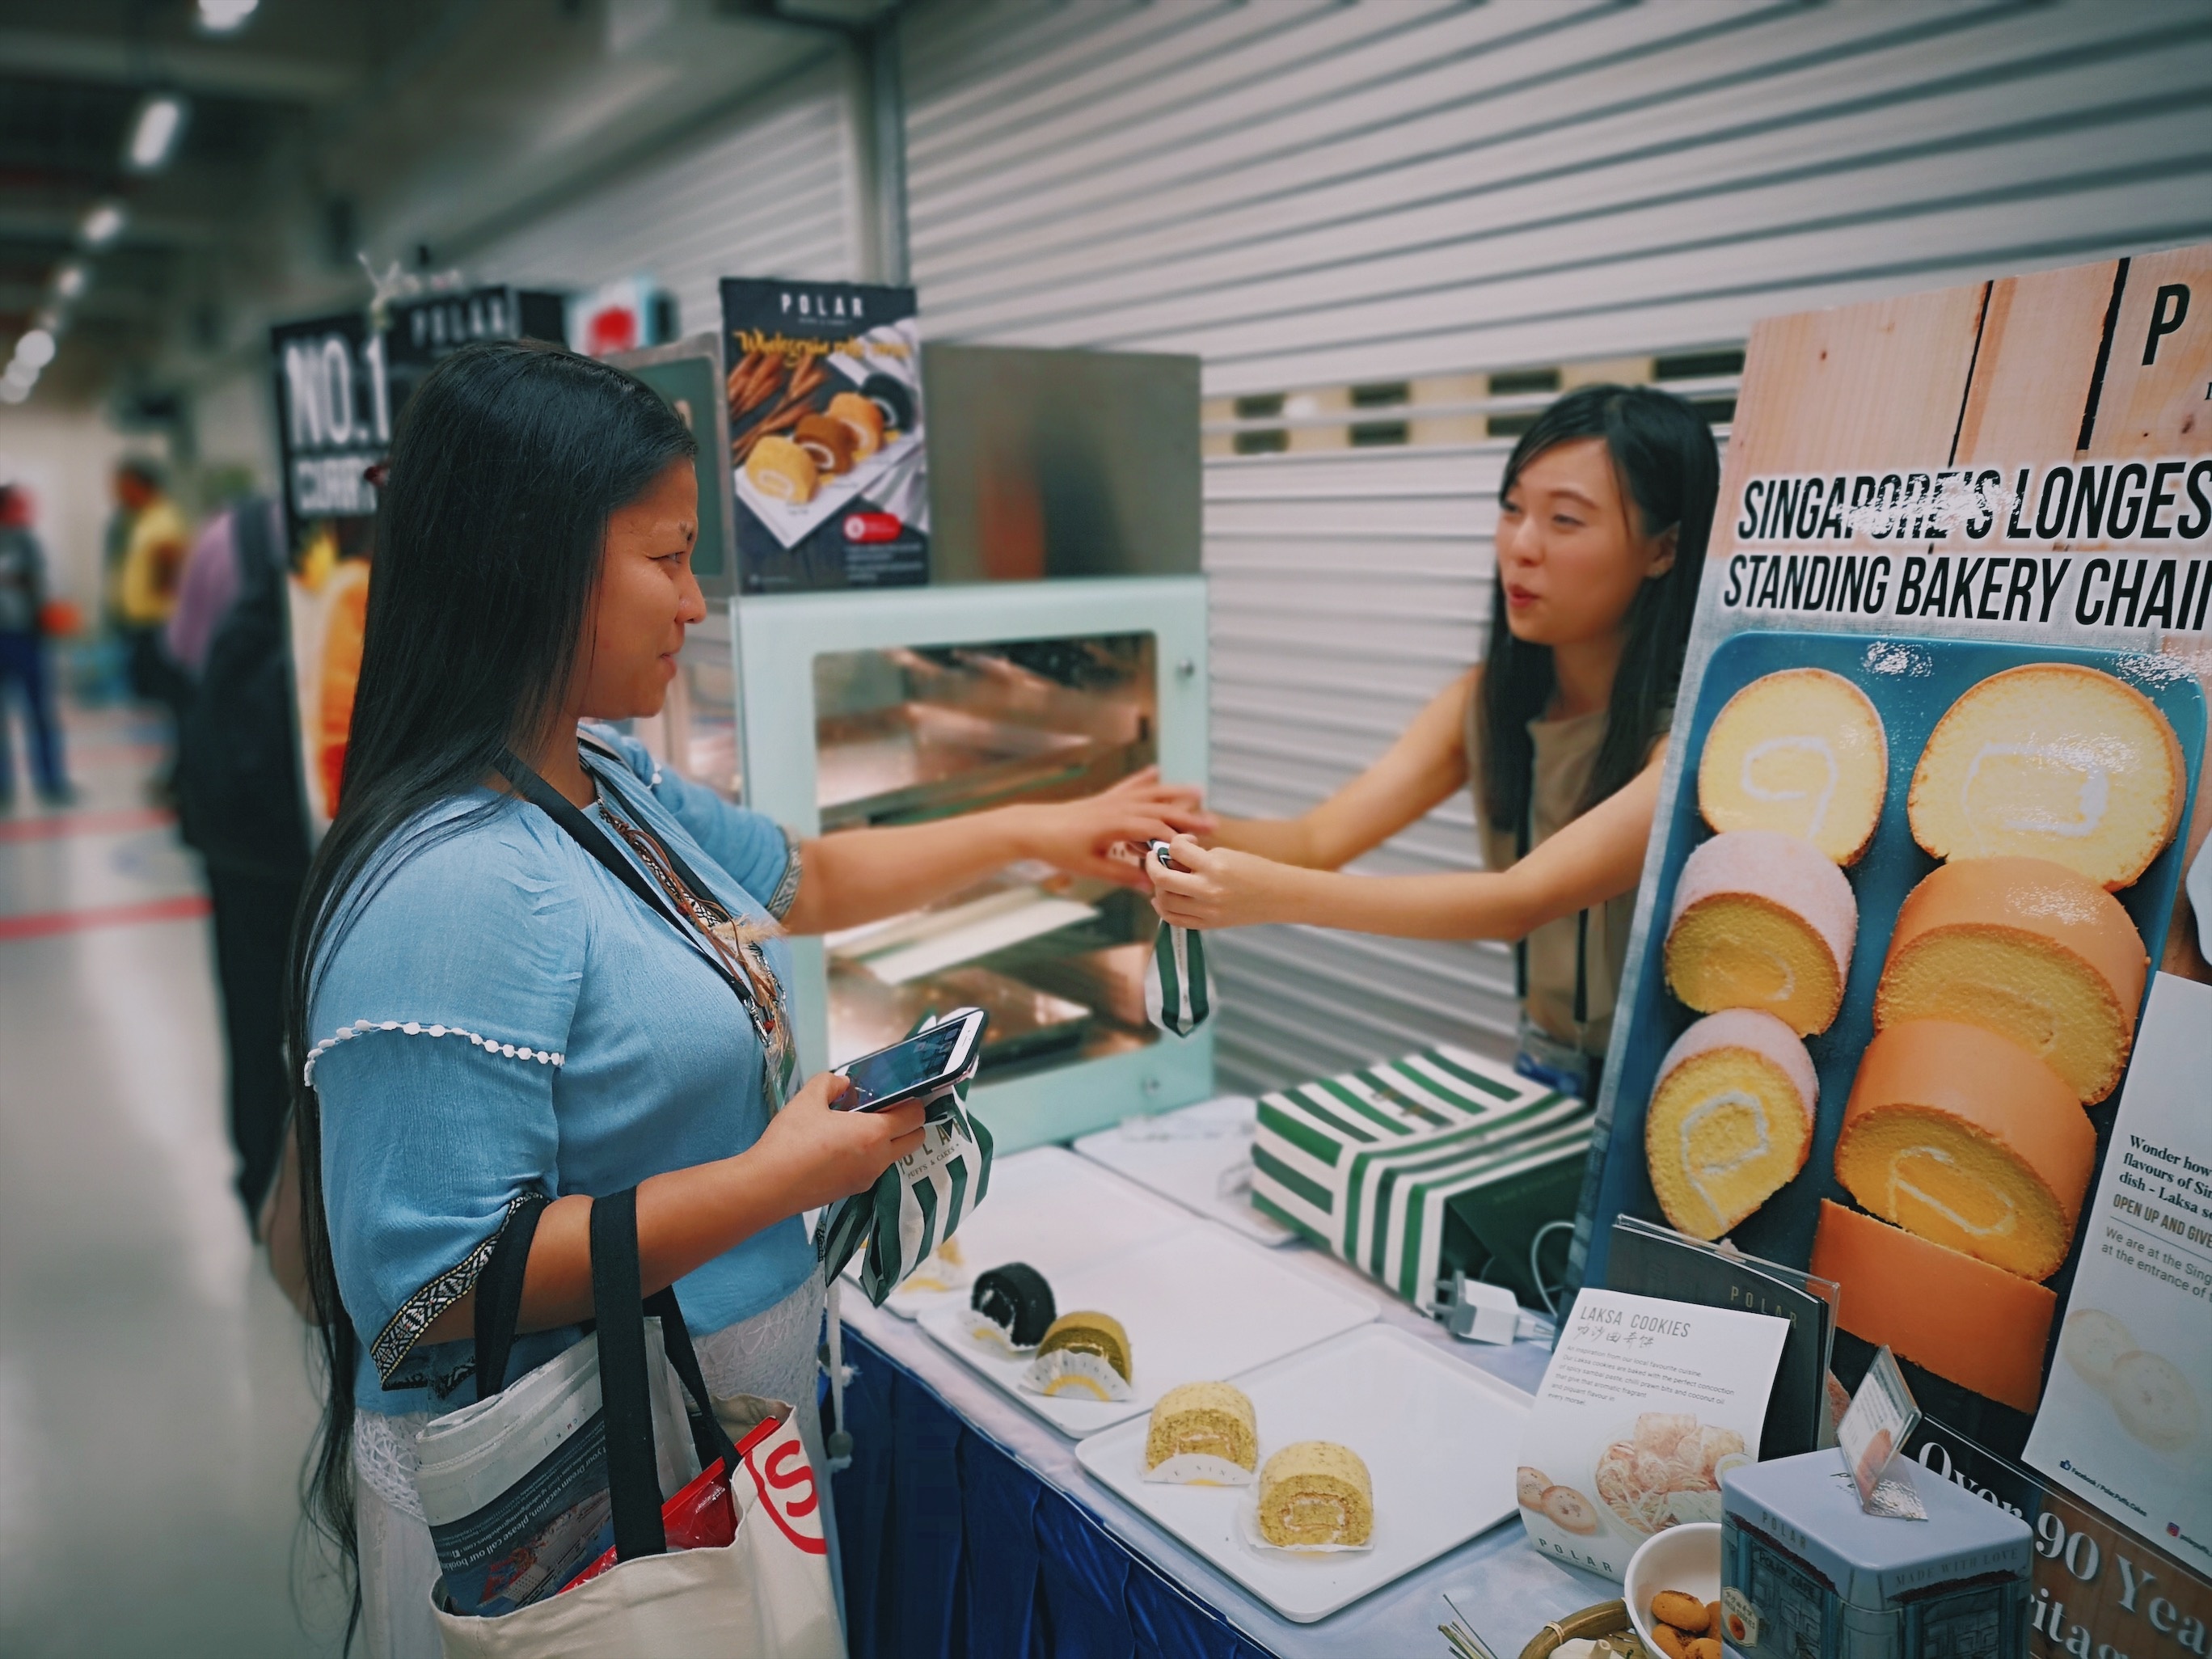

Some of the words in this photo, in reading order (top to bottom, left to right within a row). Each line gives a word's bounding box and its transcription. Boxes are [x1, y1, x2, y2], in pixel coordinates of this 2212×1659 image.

[781, 293, 863, 317] POLAR
[285, 331, 390, 445] NO.1
[1724, 554, 1890, 614] STANDING
[1895, 556, 2072, 623] BAKERY
[907, 1164, 928, 1180] PUFFS
[936, 1147, 955, 1162] CAKES
[2123, 1152, 2174, 1183] flavours
[2177, 1177, 2193, 1189] of
[2130, 1134, 2181, 1164] Wonder
[2183, 1156, 2212, 1177] how
[2119, 1171, 2146, 1192] dish
[2158, 1186, 2198, 1214] Laksa
[2113, 1193, 2142, 1217] OPEN
[2144, 1206, 2159, 1223] UP
[2160, 1214, 2185, 1235] AND
[2187, 1226, 2212, 1249] GIVE
[2105, 1226, 2123, 1243] We
[2126, 1238, 2145, 1252] are
[2147, 1248, 2159, 1260] at
[2163, 1253, 2182, 1269] the
[2101, 1244, 2113, 1255] at
[2116, 1249, 2134, 1265] the
[2137, 1260, 2189, 1290] entrance
[2193, 1286, 2207, 1298] of
[1581, 1306, 1623, 1326] LAKSA
[1630, 1314, 1691, 1338] COOKIES
[1730, 1285, 1797, 1329] POLAR
[1574, 1357, 1592, 1366] Laksa
[1592, 1360, 1615, 1370] cookies
[1627, 1366, 1647, 1376] baked
[1648, 1372, 1661, 1380] with
[1673, 1377, 1697, 1387] perfect
[1698, 1382, 1735, 1395] concoction
[1576, 1347, 1606, 1358] inspiration
[1607, 1353, 1621, 1361] from
[1634, 1358, 1649, 1366] local
[1649, 1361, 1678, 1372] favourite
[1548, 1393, 1563, 1401] every
[1566, 1366, 1581, 1374] spicy
[1583, 1368, 1604, 1378] sambal
[1640, 1381, 1660, 1390] prawn
[1661, 1385, 1673, 1393] bits
[1674, 1388, 1687, 1396] and
[1687, 1391, 1715, 1403] coconut
[1587, 1390, 1608, 1400] flavour
[1594, 1381, 1621, 1392] aromatic
[1623, 1387, 1647, 1398] fragrant
[586, 1448, 602, 1467] your
[561, 1465, 586, 1488] Dream
[503, 1514, 530, 1541] please
[1762, 1511, 1807, 1549] POLAR
[469, 1549, 485, 1563] our
[486, 1538, 503, 1555] call
[1539, 1538, 1613, 1572] POLAR
[1896, 1567, 1935, 1587] MADE
[1941, 1556, 1977, 1573] WITH
[1983, 1547, 2019, 1565] LOVE
[2036, 1512, 2100, 1581] 90
[2115, 1553, 2212, 1659] Yea
